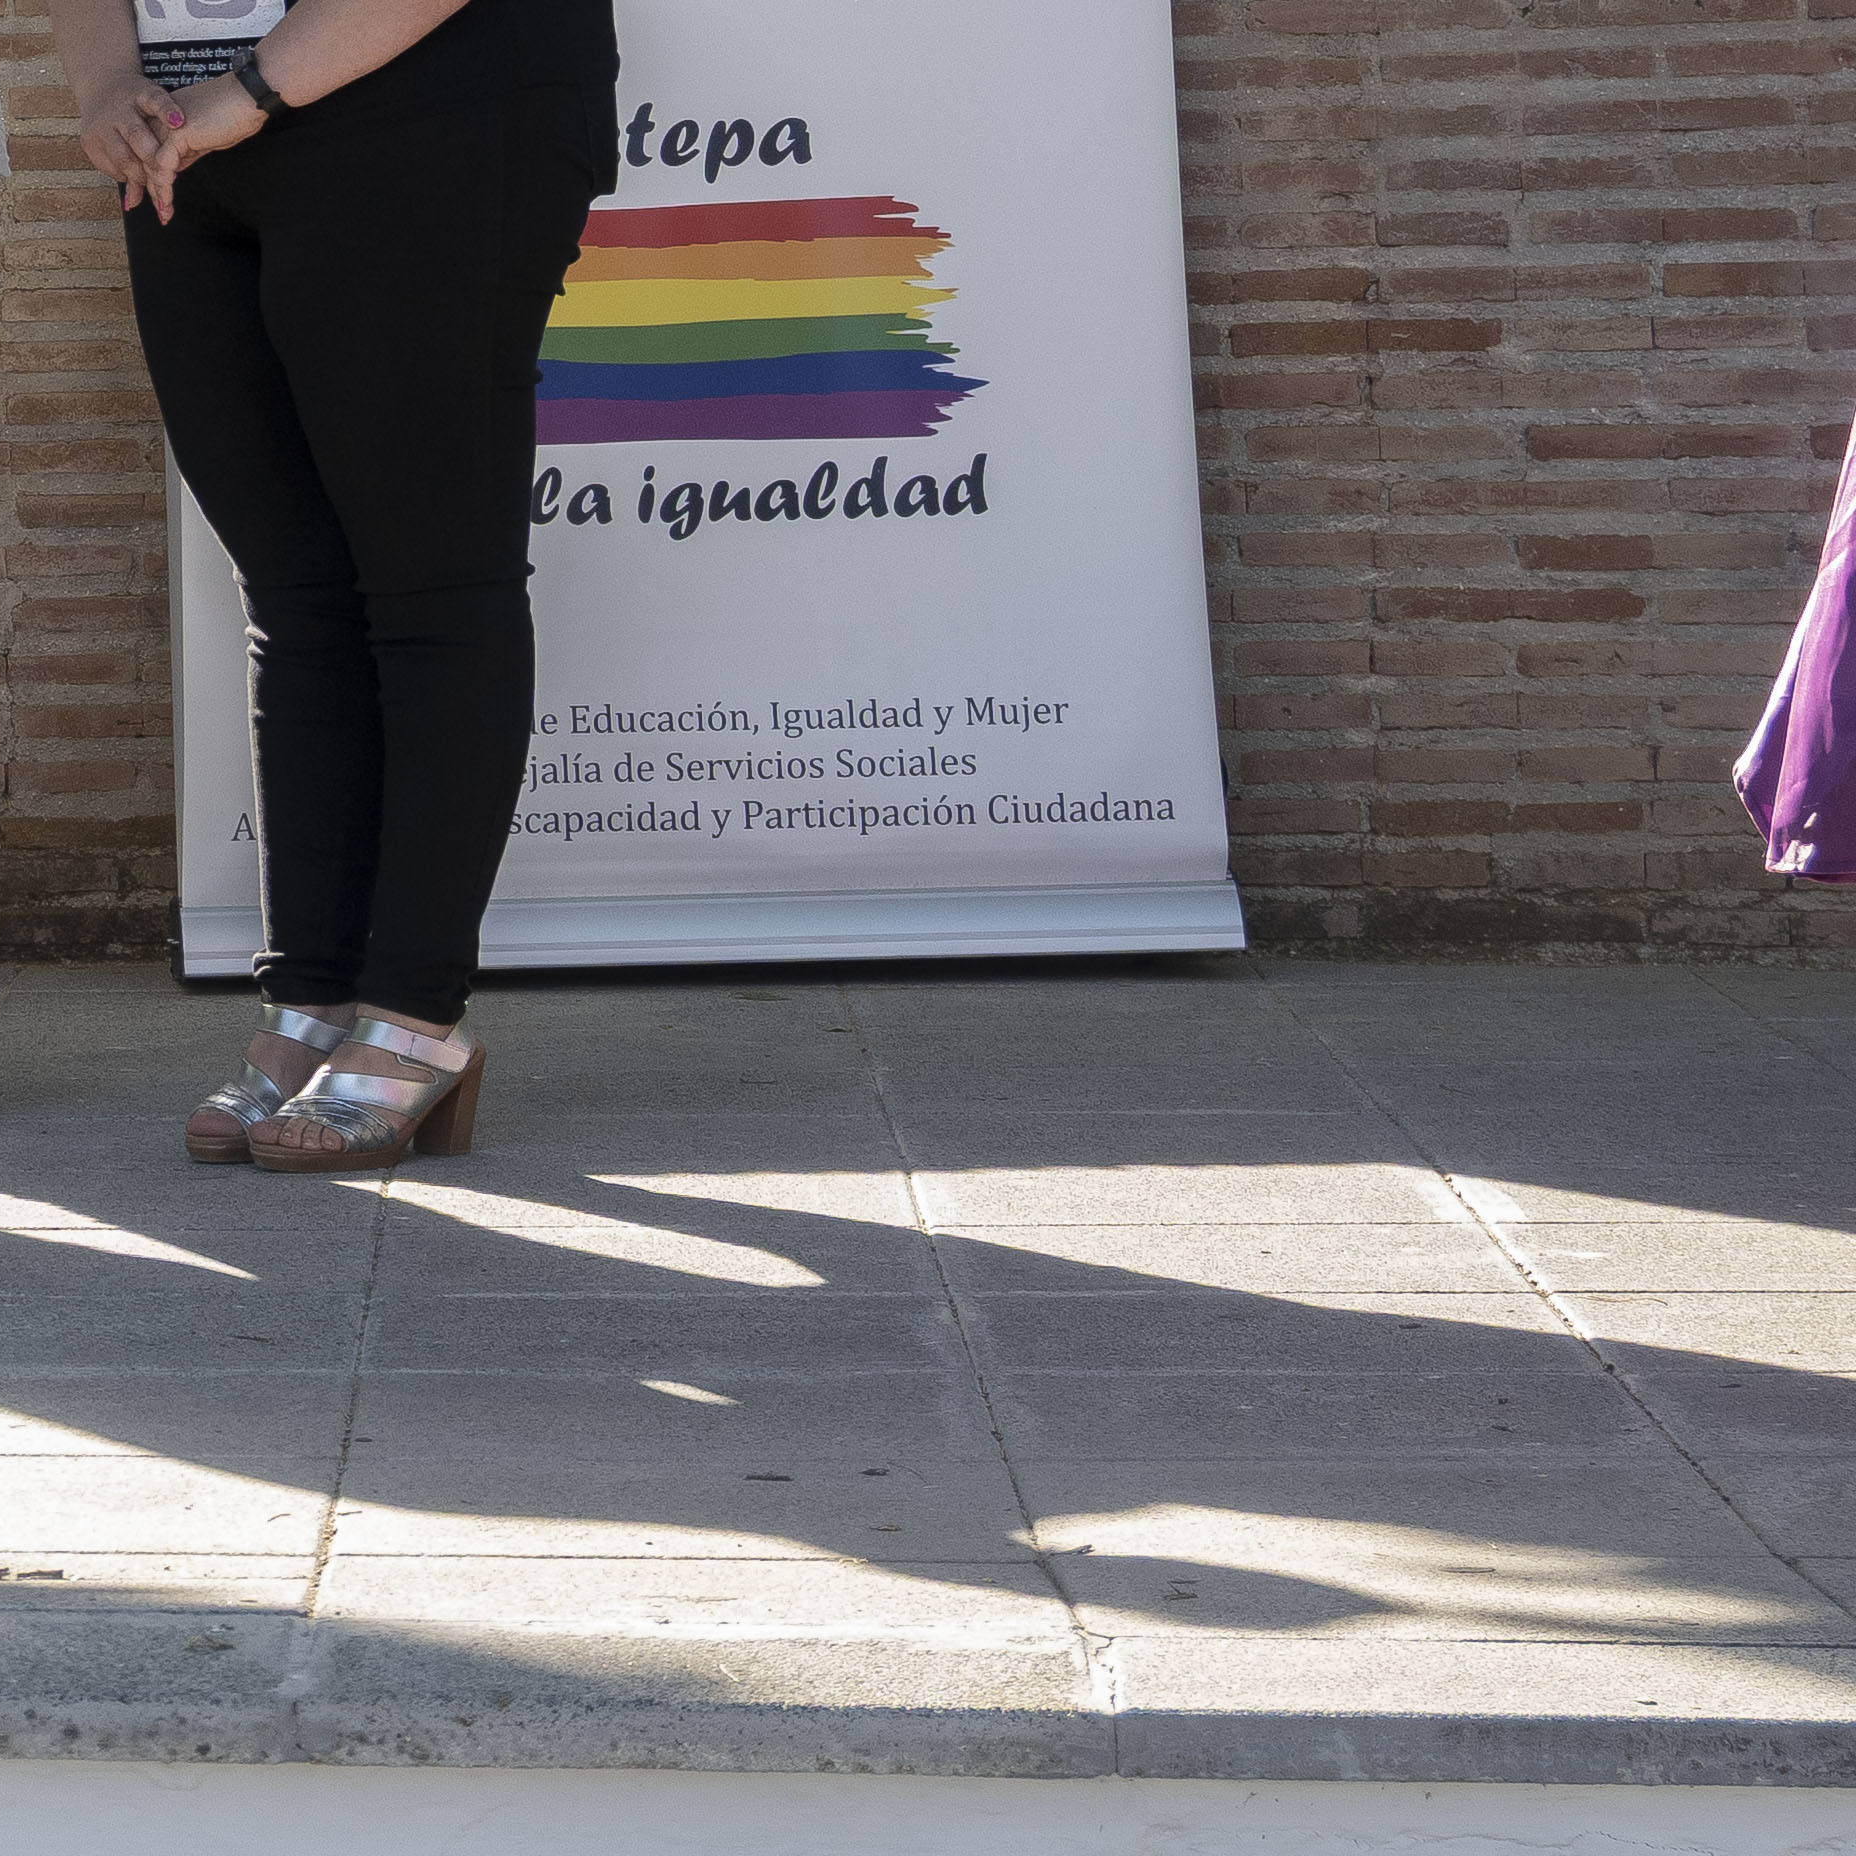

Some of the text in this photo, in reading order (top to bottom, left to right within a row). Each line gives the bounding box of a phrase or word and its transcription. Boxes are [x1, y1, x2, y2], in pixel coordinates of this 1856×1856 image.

[160, 63, 181, 73] Good
[188, 48, 214, 58] decide
[215, 47, 235, 57] their
[618, 102, 813, 184] tepa
[531, 453, 989, 540] la igualdad
[531, 696, 1069, 738] e Educación, Igualdad y Mujer
[521, 746, 978, 793] jalía de Servicios Sociales
[711, 808, 732, 838] y
[742, 795, 977, 836] Participación
[988, 791, 1176, 824] Ciudadana
